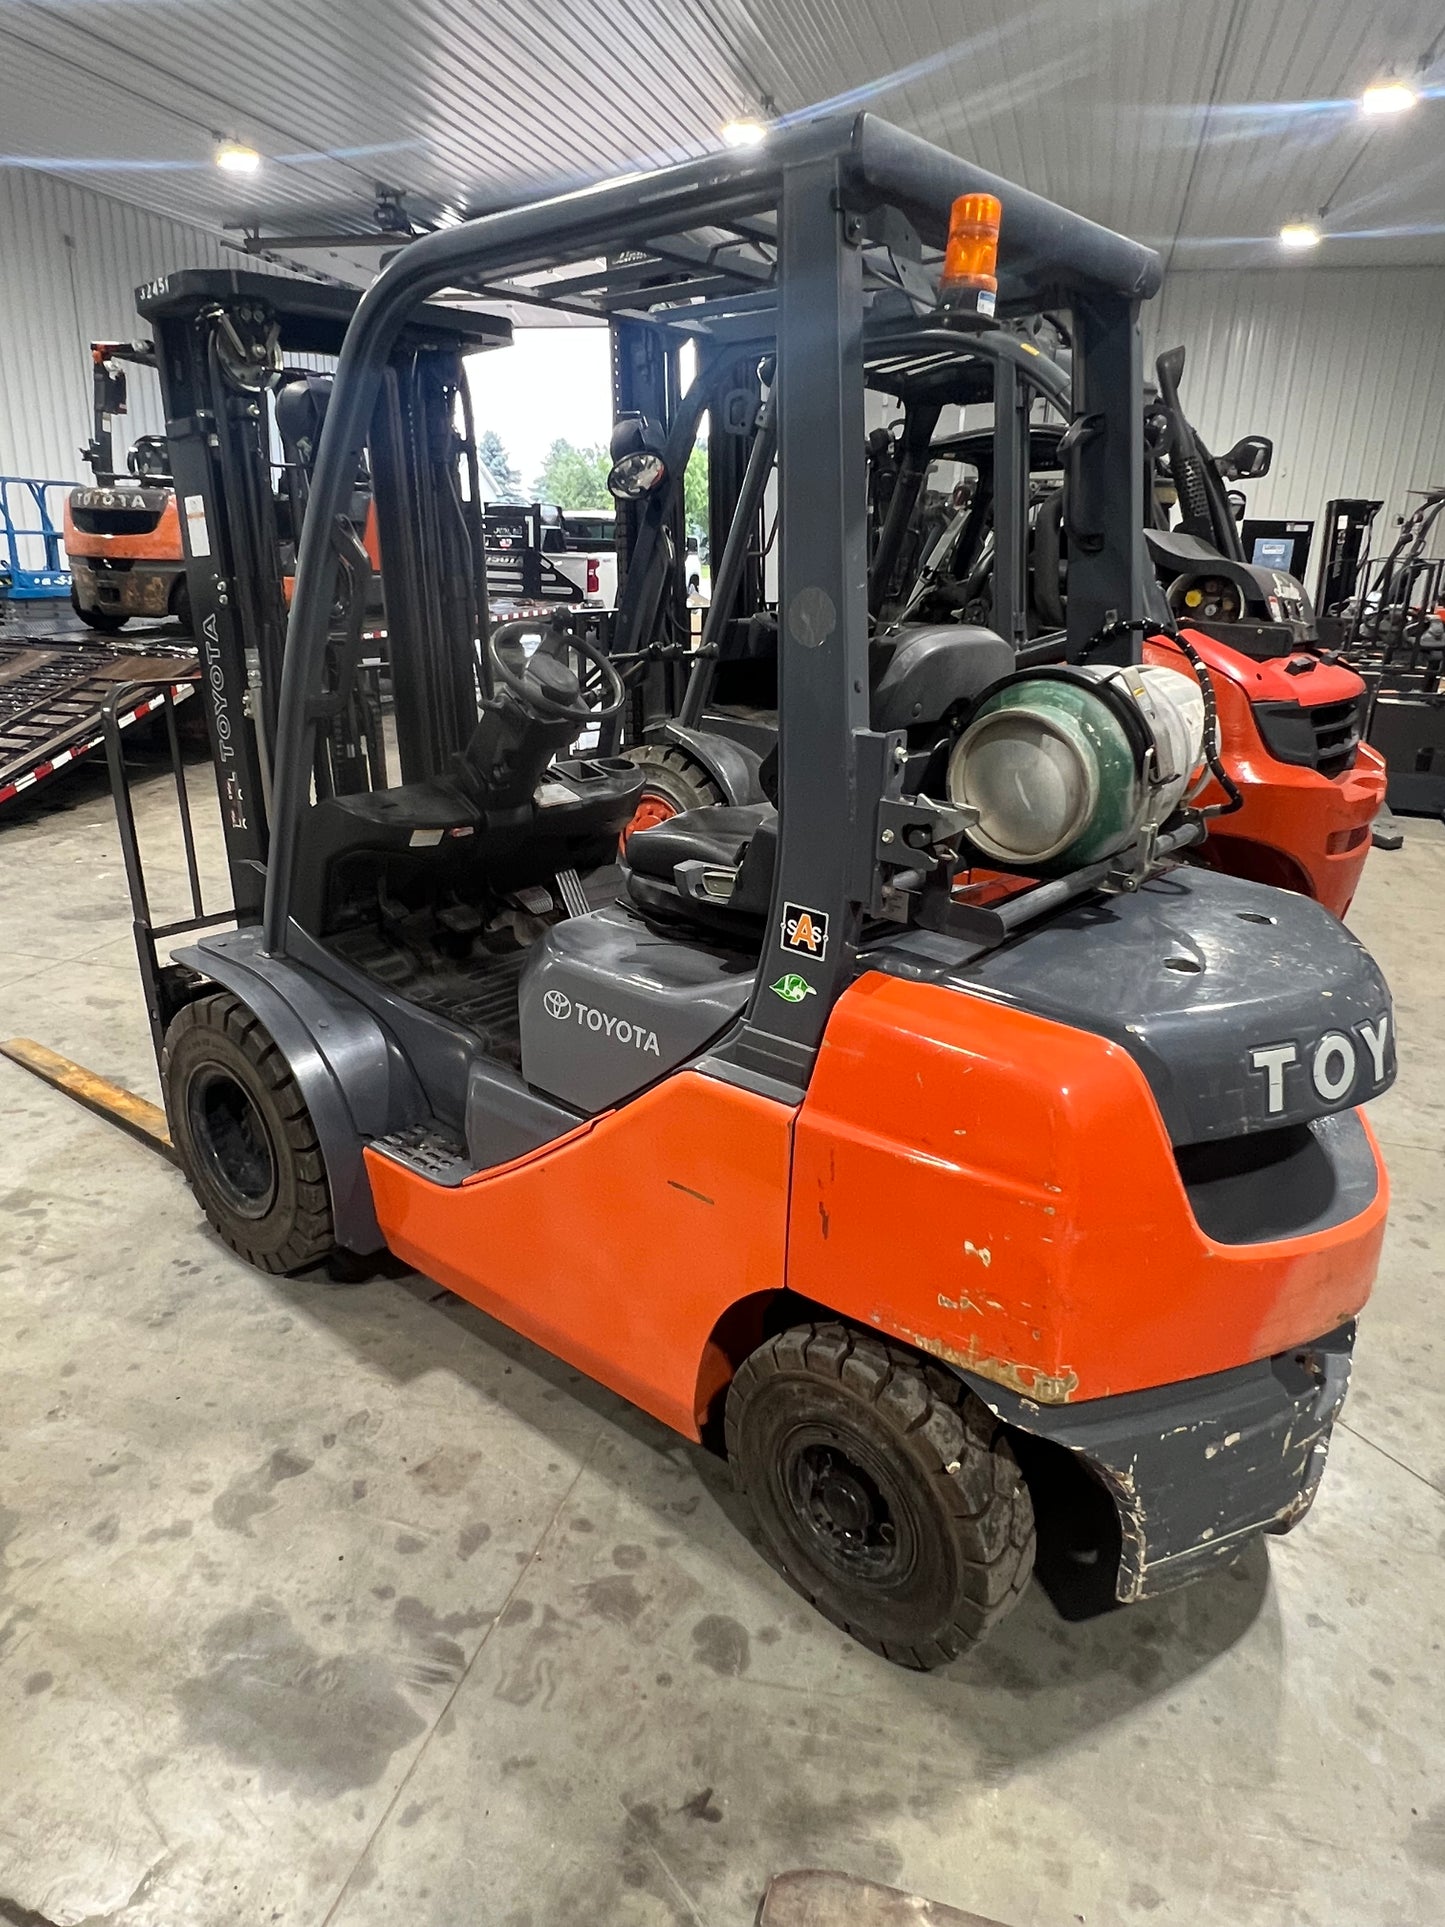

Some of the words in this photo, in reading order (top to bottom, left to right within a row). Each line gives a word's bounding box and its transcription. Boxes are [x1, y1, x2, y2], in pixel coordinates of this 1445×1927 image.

[77, 492, 146, 508] TOYOTA
[203, 613, 235, 763] TOYOTA
[786, 913, 823, 952] SAS
[575, 1002, 660, 1057] TOYOTA
[1253, 1017, 1388, 1113] TOY
